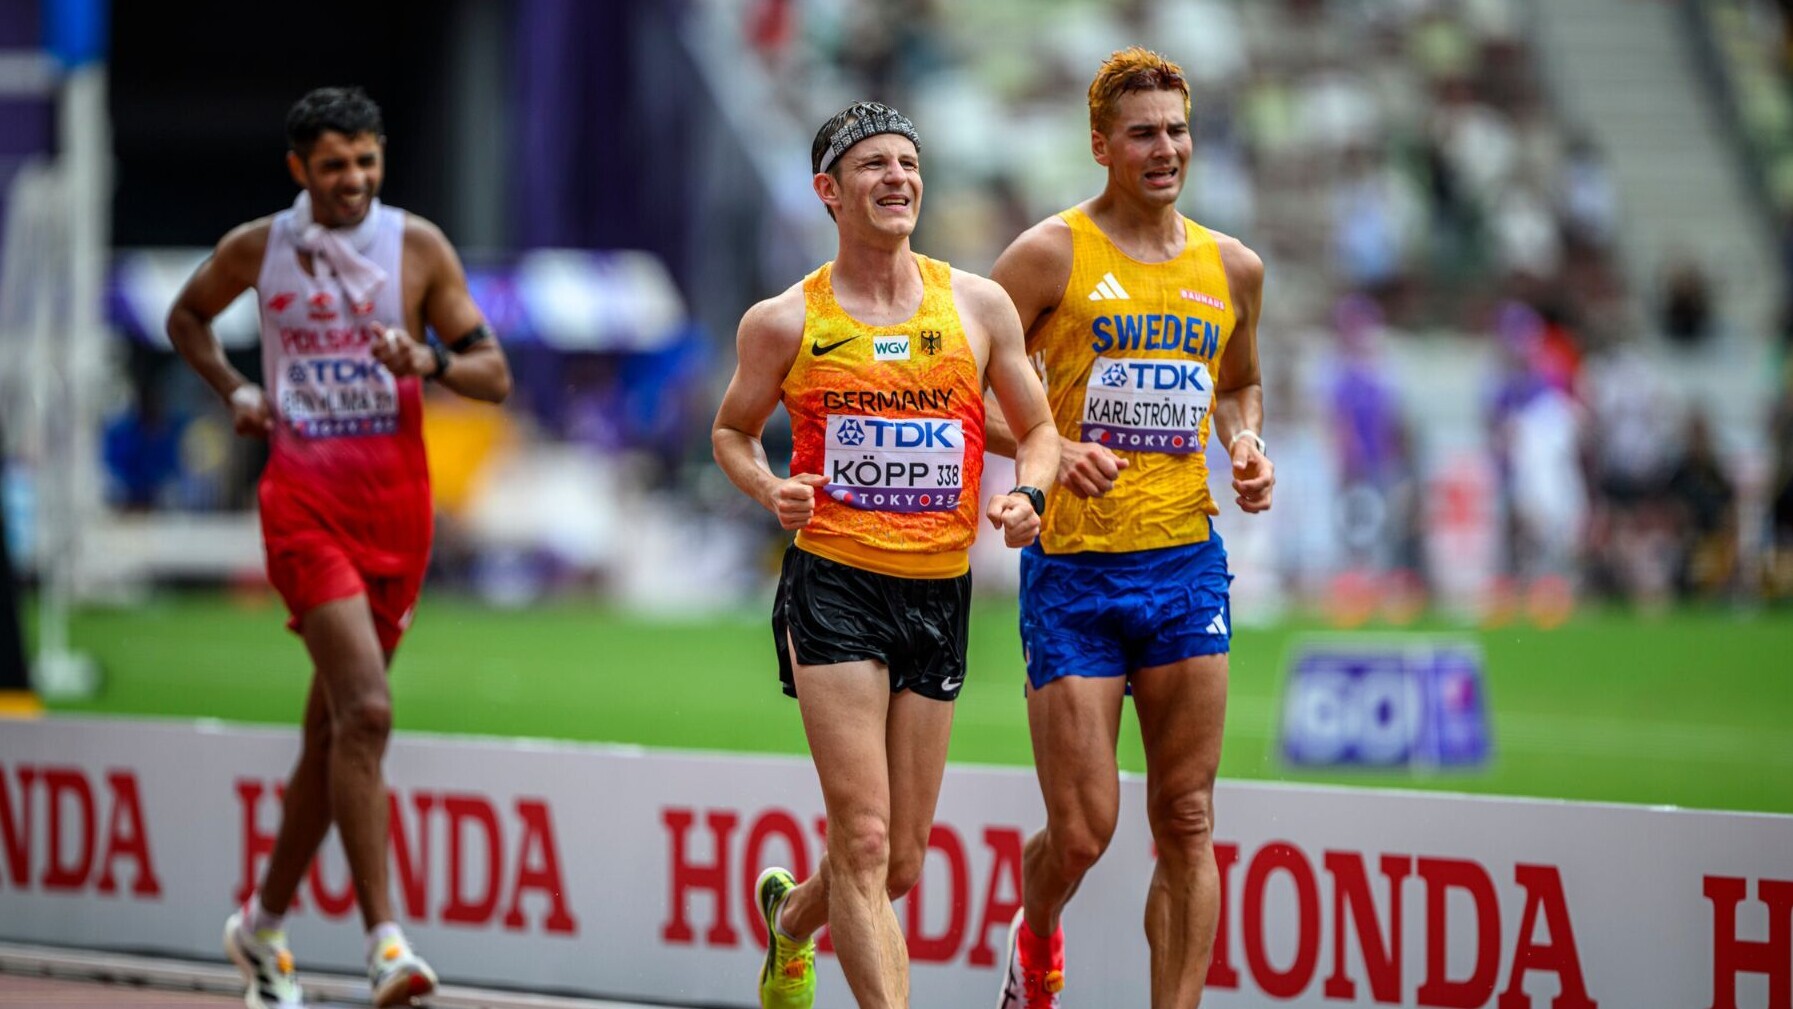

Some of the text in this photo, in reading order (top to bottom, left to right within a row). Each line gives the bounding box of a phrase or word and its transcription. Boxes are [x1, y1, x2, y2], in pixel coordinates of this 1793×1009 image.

[1181, 290, 1225, 310] BAUHAUS
[280, 326, 371, 354] POLSKA
[874, 341, 909, 355] WGV
[1091, 314, 1220, 361] SWEDEN
[309, 360, 385, 384] TDK
[1128, 363, 1205, 392] TDK
[823, 388, 954, 412] GERMANY
[1087, 397, 1186, 428] KARLSTRÖM
[864, 420, 955, 449] TDK
[832, 455, 960, 487] KÖPP 338
[661, 808, 1024, 970] HODA
